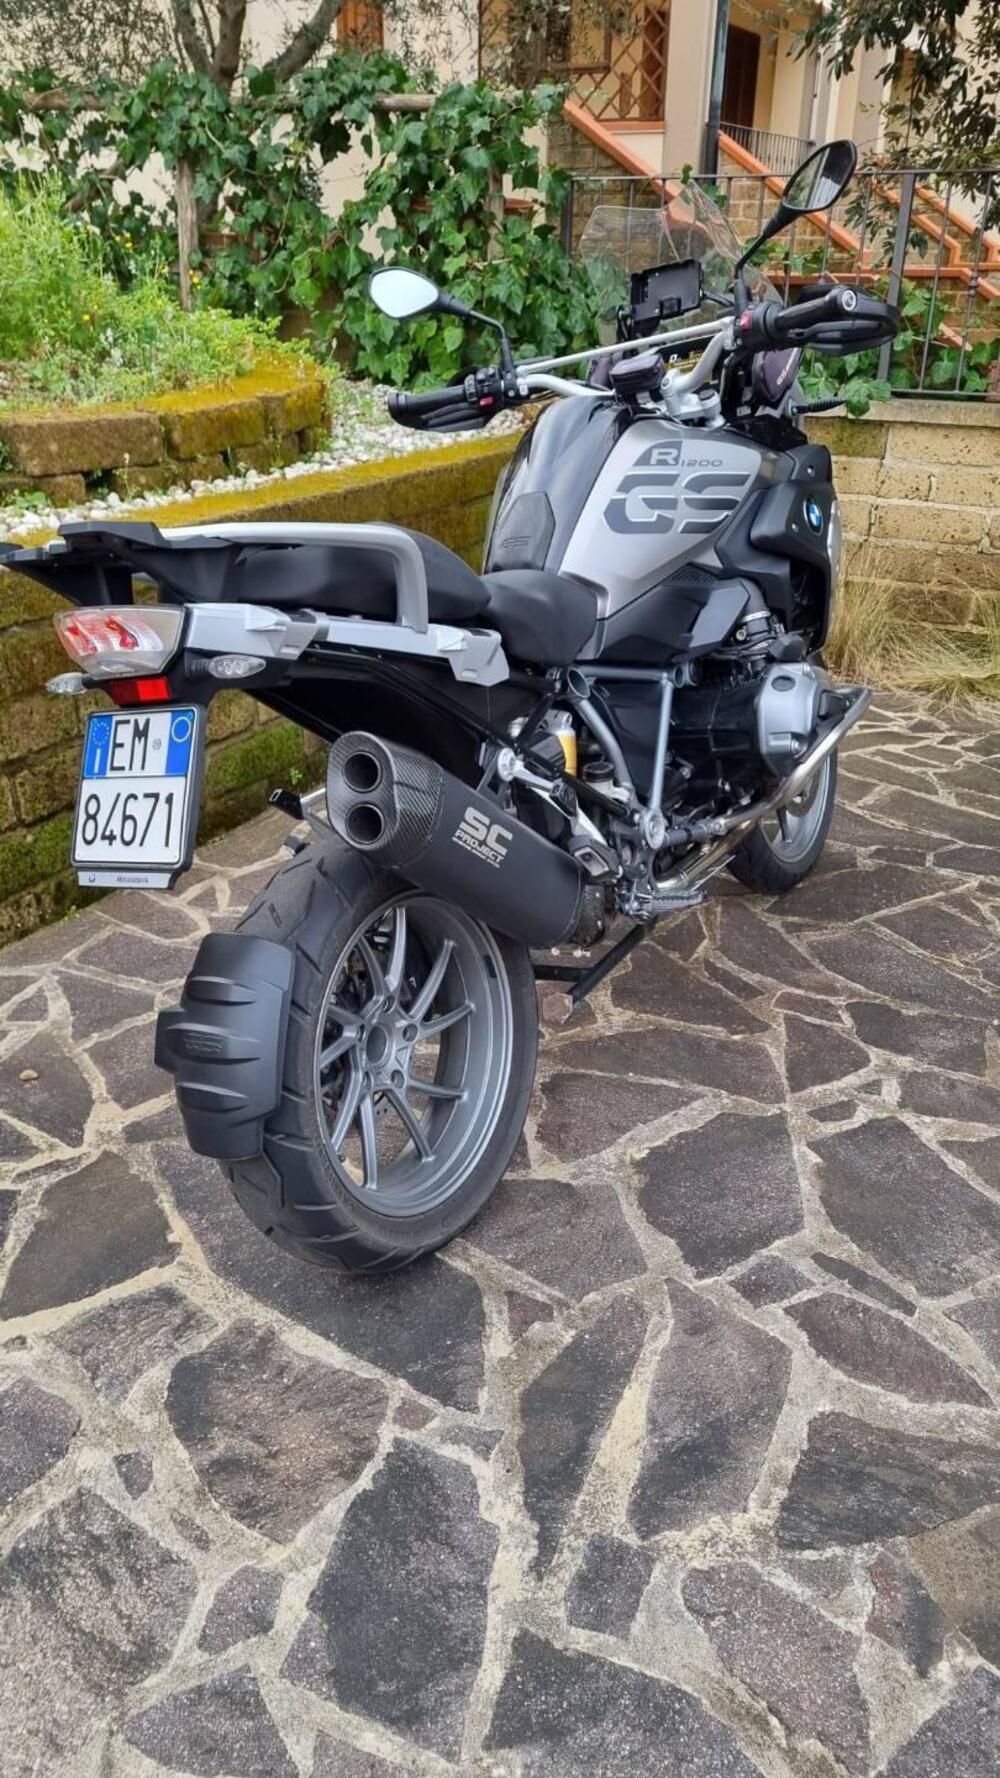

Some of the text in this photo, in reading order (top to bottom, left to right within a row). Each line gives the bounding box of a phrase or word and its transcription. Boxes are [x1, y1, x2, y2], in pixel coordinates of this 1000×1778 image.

[650, 448, 723, 468] R 1200
[603, 471, 752, 534] GS
[109, 718, 150, 772] EM
[82, 792, 174, 848] 84671
[454, 829, 504, 863] PROJECT
[459, 806, 513, 856] SC
